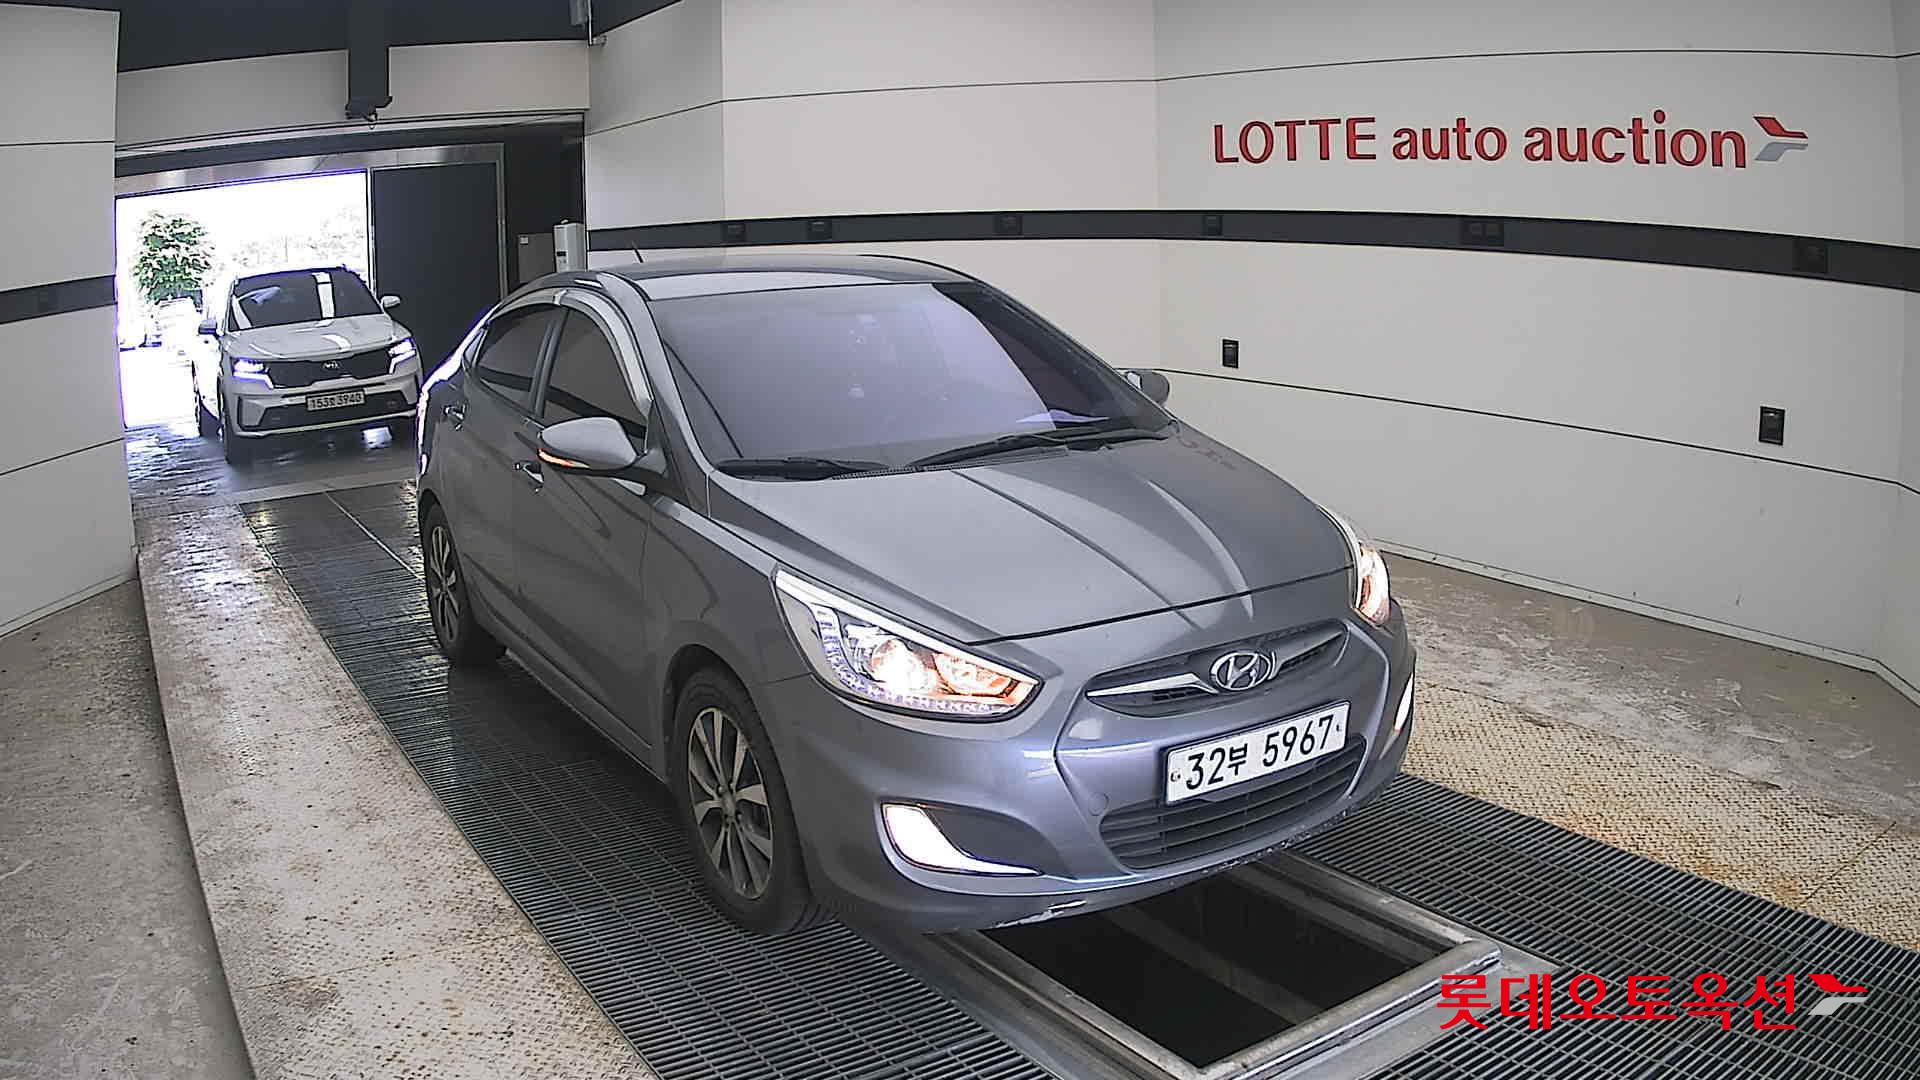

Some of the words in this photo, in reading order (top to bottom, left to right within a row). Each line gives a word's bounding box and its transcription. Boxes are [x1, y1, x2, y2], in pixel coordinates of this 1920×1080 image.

[1213, 116, 1377, 164] LOTTE
[1391, 116, 1508, 162] auto
[1523, 109, 1748, 169] auction
[1185, 742, 1248, 790] 32부
[1262, 714, 1335, 767] 5967
